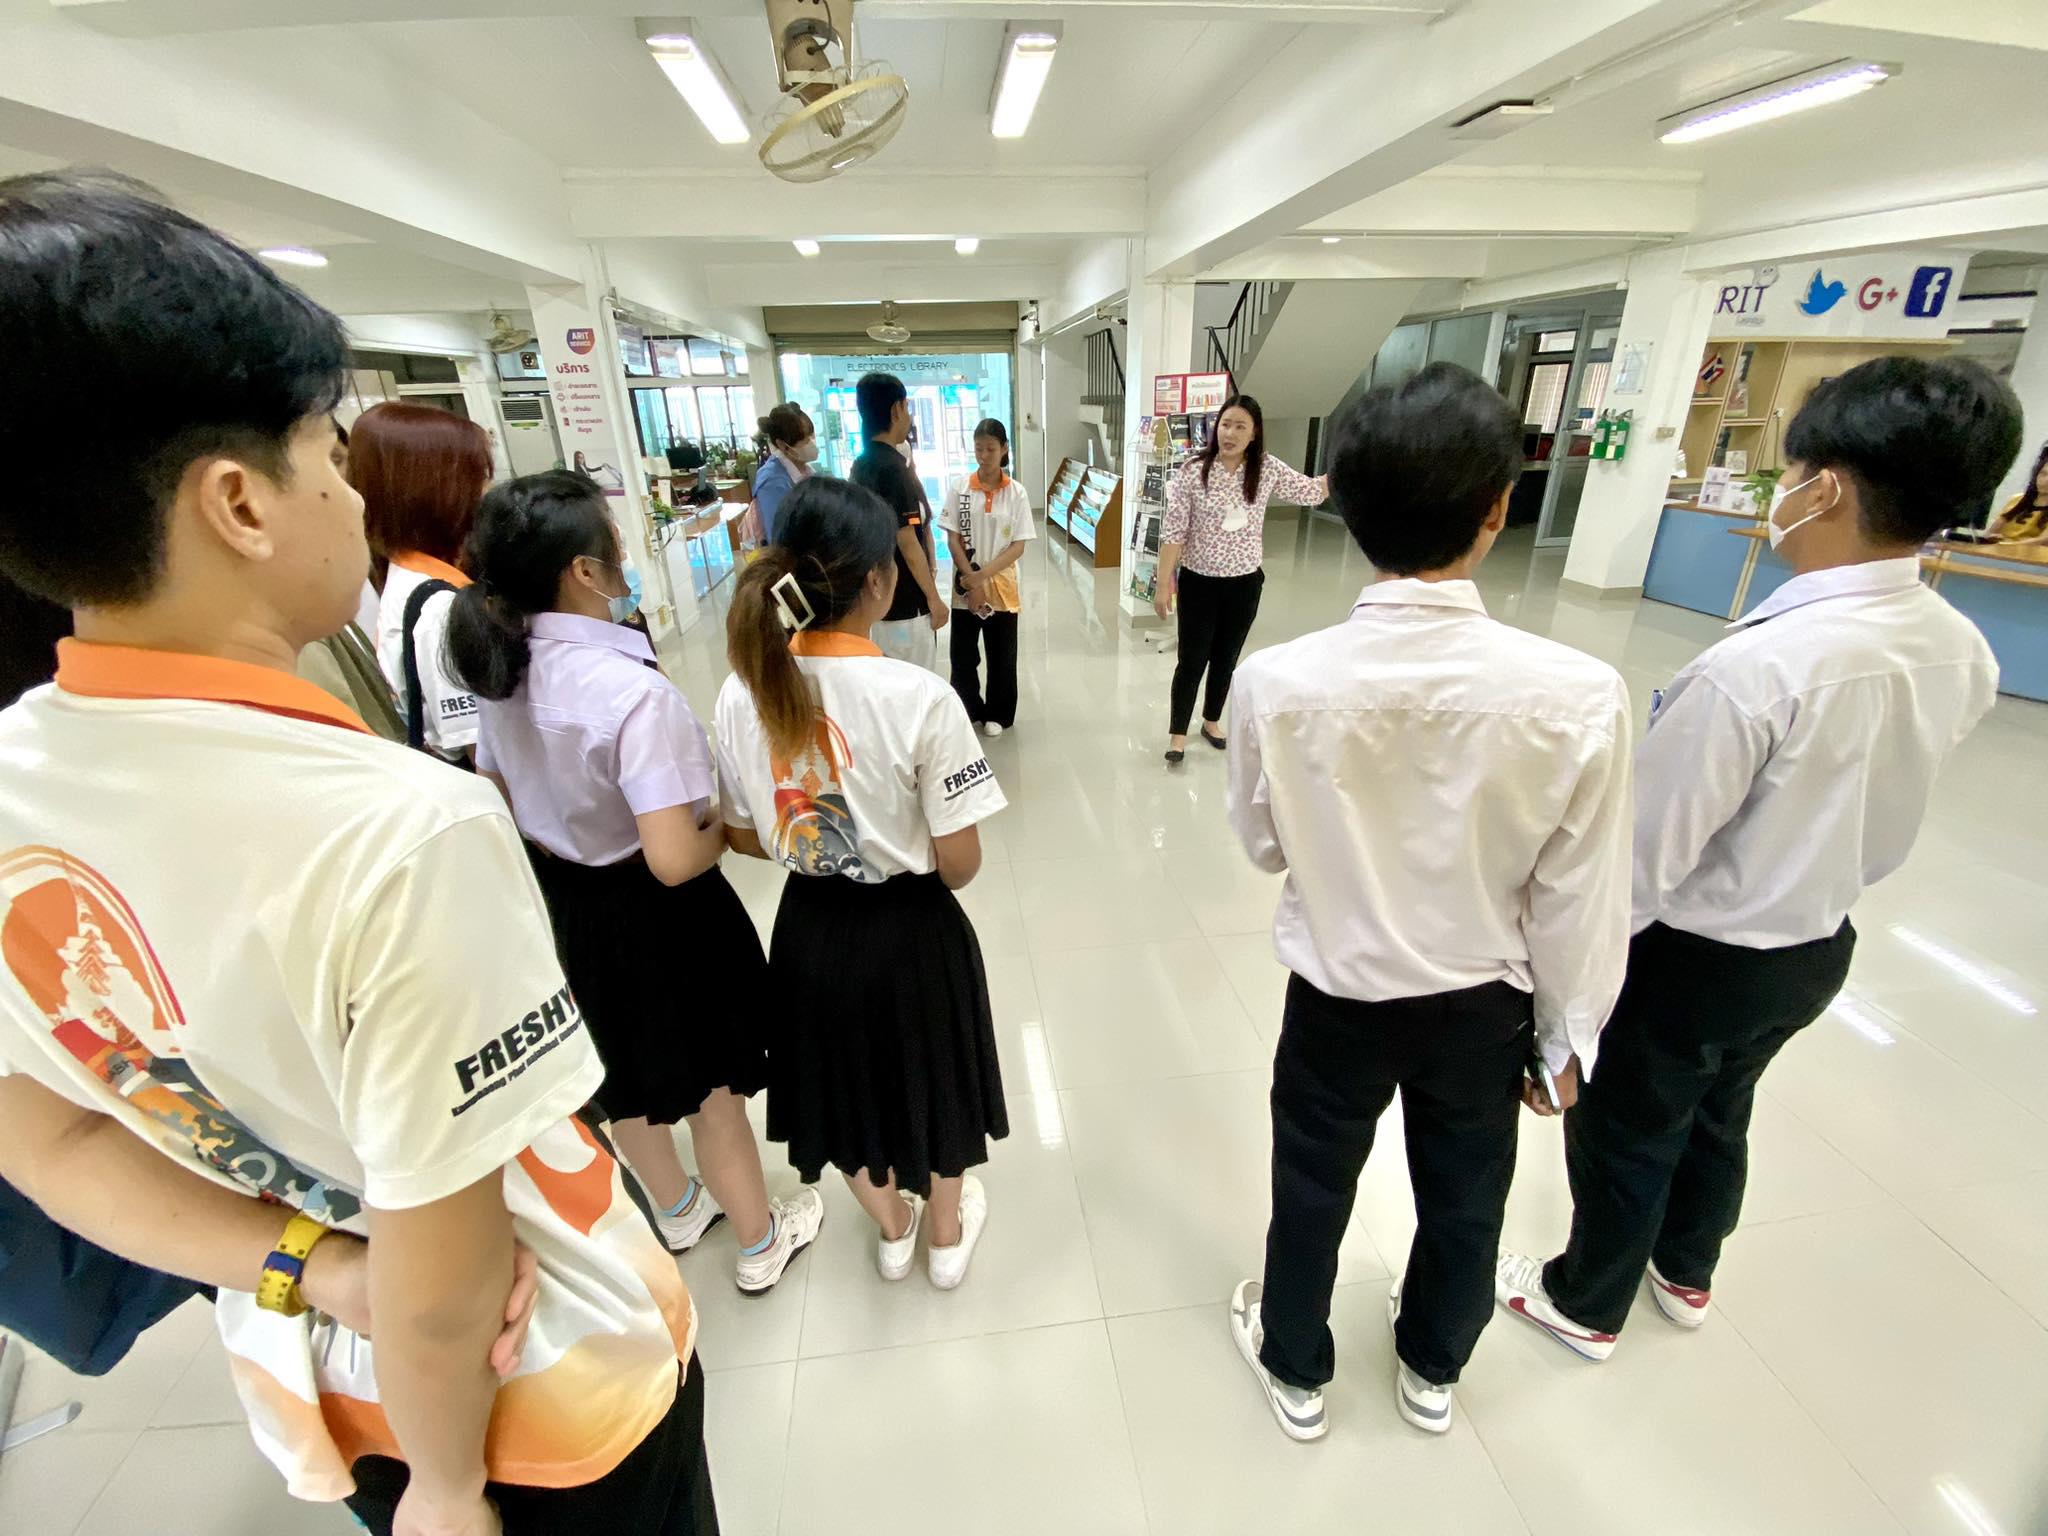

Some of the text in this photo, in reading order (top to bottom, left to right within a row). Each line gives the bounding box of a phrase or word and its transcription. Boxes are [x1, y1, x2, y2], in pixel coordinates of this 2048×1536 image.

[1714, 285, 1768, 314] RIT
[1858, 277, 1899, 311] G+
[556, 362, 590, 374] บริการ
[847, 361, 949, 371] ELECTRONICS LIBRARY
[959, 494, 972, 547] FRESHY
